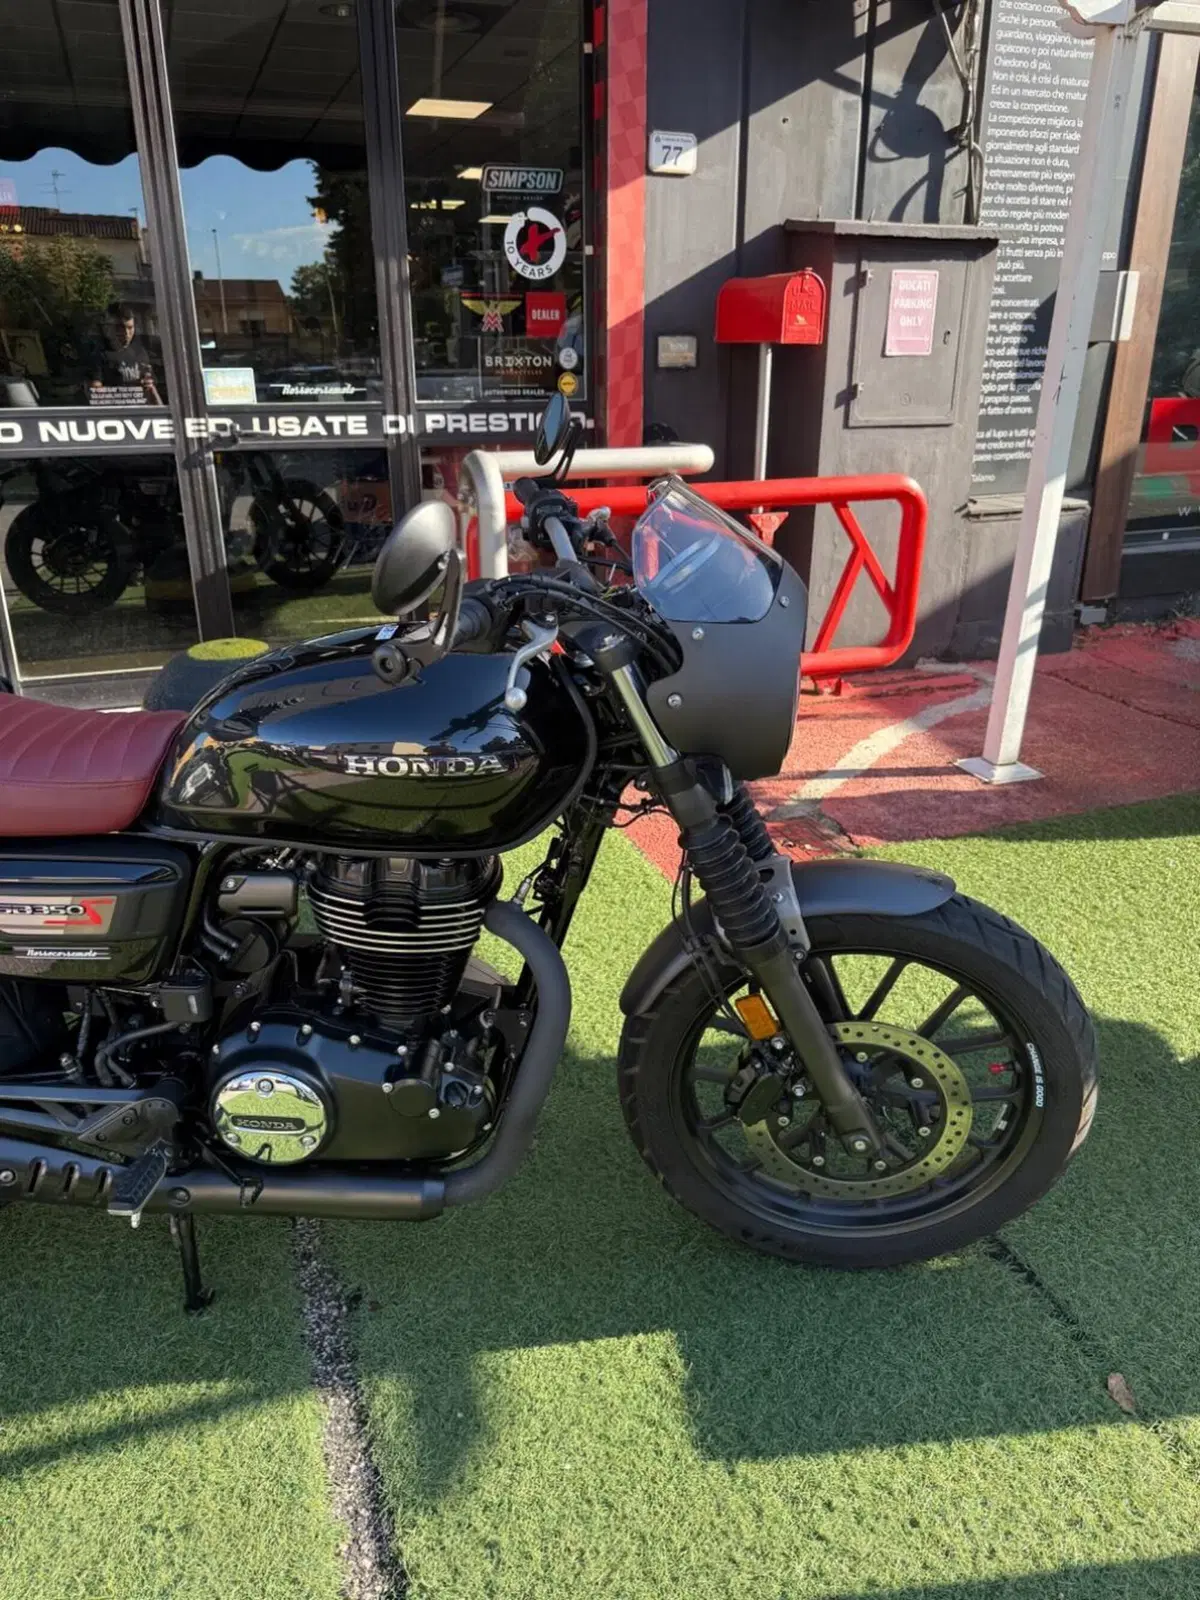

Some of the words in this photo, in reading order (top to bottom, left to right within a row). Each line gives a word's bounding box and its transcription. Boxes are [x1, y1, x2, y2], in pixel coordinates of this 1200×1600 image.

[1013, 2, 1042, 12] costano
[1043, 4, 1063, 14] come
[1035, 32, 1072, 45] viaggiano,
[1037, 46, 1050, 57] poi
[993, 56, 1030, 67] Chiedono
[1030, 58, 1038, 69] di
[992, 70, 1009, 81] Non
[1038, 74, 1052, 84] crisi
[1052, 74, 1060, 85] di
[991, 84, 1001, 95] Ed
[1002, 86, 1010, 96] in
[1010, 87, 1021, 97] un
[1021, 88, 1051, 98] mercato
[1052, 89, 1065, 100] che
[989, 100, 1012, 109] cresce
[1012, 101, 1020, 110] la
[988, 112, 997, 122] La
[998, 114, 1046, 126] competizione
[1047, 116, 1077, 129] migliora
[1077, 118, 1084, 128] la
[987, 126, 1029, 138] imponendo
[1029, 128, 1049, 139] sforzi
[1049, 131, 1062, 142] per
[985, 141, 1034, 152] giornalmente
[1034, 143, 1048, 155] agli
[1049, 144, 1080, 155] standard
[662, 145, 683, 166] 77
[984, 153, 993, 163] La
[994, 154, 1031, 165] situazione
[1031, 157, 1046, 166] non
[1052, 157, 1070, 168] dura,
[488, 170, 557, 189] SIMPSON
[989, 168, 1040, 179] estremamente
[1005, 182, 1027, 192] molto
[1028, 182, 1065, 195] divertente,
[994, 194, 1005, 204] chi
[1005, 196, 1031, 205] accetta
[1031, 196, 1039, 205] di
[1039, 196, 1057, 206] stare
[1057, 197, 1069, 206] nel
[980, 208, 1009, 218] secondo
[1009, 209, 1032, 220] regole
[1040, 224, 1064, 234] poteva
[1030, 236, 1058, 247] impresa,
[506, 240, 516, 255] 10
[513, 257, 553, 277] YEARS
[1006, 247, 1024, 257] frutti
[1024, 249, 1044, 258] senza
[894, 298, 933, 310] PARKING
[1001, 297, 1041, 308] concentrati.
[531, 309, 561, 320] DEALER
[899, 316, 924, 327] ONLY
[1002, 336, 1028, 346] proprio
[484, 354, 553, 368] BRIXTON
[997, 384, 1009, 393] per
[984, 394, 1009, 404] proprio
[40, 419, 174, 442] NUOVE
[252, 415, 368, 437] USATE
[383, 414, 414, 434] DI
[992, 428, 1008, 440] lupo
[992, 450, 1032, 462] competitivo
[343, 753, 509, 777] HONDA
[1035, 1075, 1044, 1084] IS
[1035, 1085, 1044, 1107] GOOD
[237, 1118, 298, 1130] HONDA
